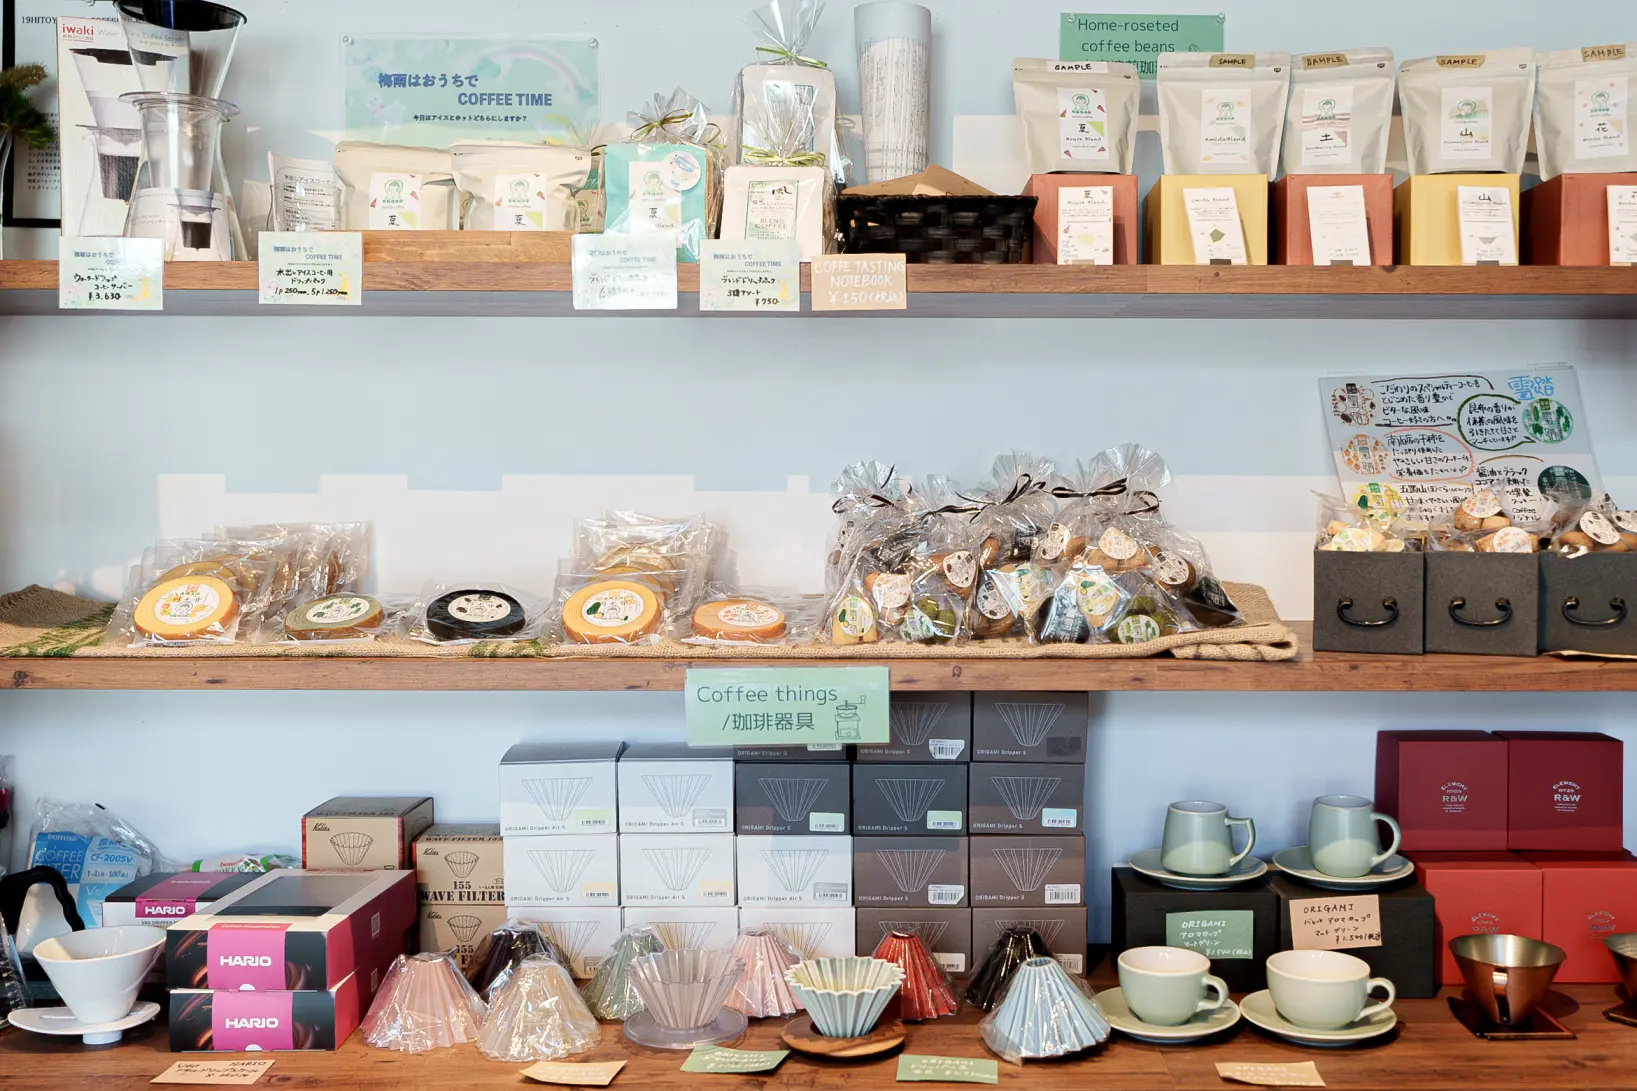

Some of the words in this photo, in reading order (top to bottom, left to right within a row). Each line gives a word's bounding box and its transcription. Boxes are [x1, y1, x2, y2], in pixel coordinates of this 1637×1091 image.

[62, 24, 94, 36] iwaki
[1078, 18, 1179, 32] Home-roseted
[1081, 40, 1130, 52] coffee
[1134, 40, 1175, 52] beans
[1583, 47, 1623, 58] SAMPLE
[1218, 58, 1247, 66] SAMPLE
[1306, 55, 1344, 66] SAMPLE
[1440, 57, 1478, 66] SAMPLE
[1054, 63, 1092, 71] SAMPLE
[378, 73, 479, 88] 梅雨はおうちで
[458, 92, 513, 106] COFFEE
[515, 92, 553, 106] TIME
[1319, 132, 1334, 142] 土
[1460, 128, 1474, 138] 山
[1478, 192, 1492, 202] 山
[814, 260, 853, 274] COFFE
[854, 260, 905, 274] TASTING
[830, 274, 893, 289] NOTEBOOK
[697, 686, 768, 703] Coffee
[775, 685, 838, 706] things
[721, 712, 815, 732] /珈琲器具
[1442, 794, 1468, 802] R&W
[1554, 794, 1581, 802] R&W
[35, 849, 84, 862] COFFEE
[453, 880, 472, 890] 155
[420, 890, 455, 902] WAVE
[458, 890, 505, 902] FILTER
[144, 905, 186, 915] HARIO
[1303, 903, 1354, 914] ORIGAMI
[1181, 920, 1226, 929] ORIGAMI
[219, 955, 272, 968] HARIO
[224, 1017, 279, 1030] HARIO
